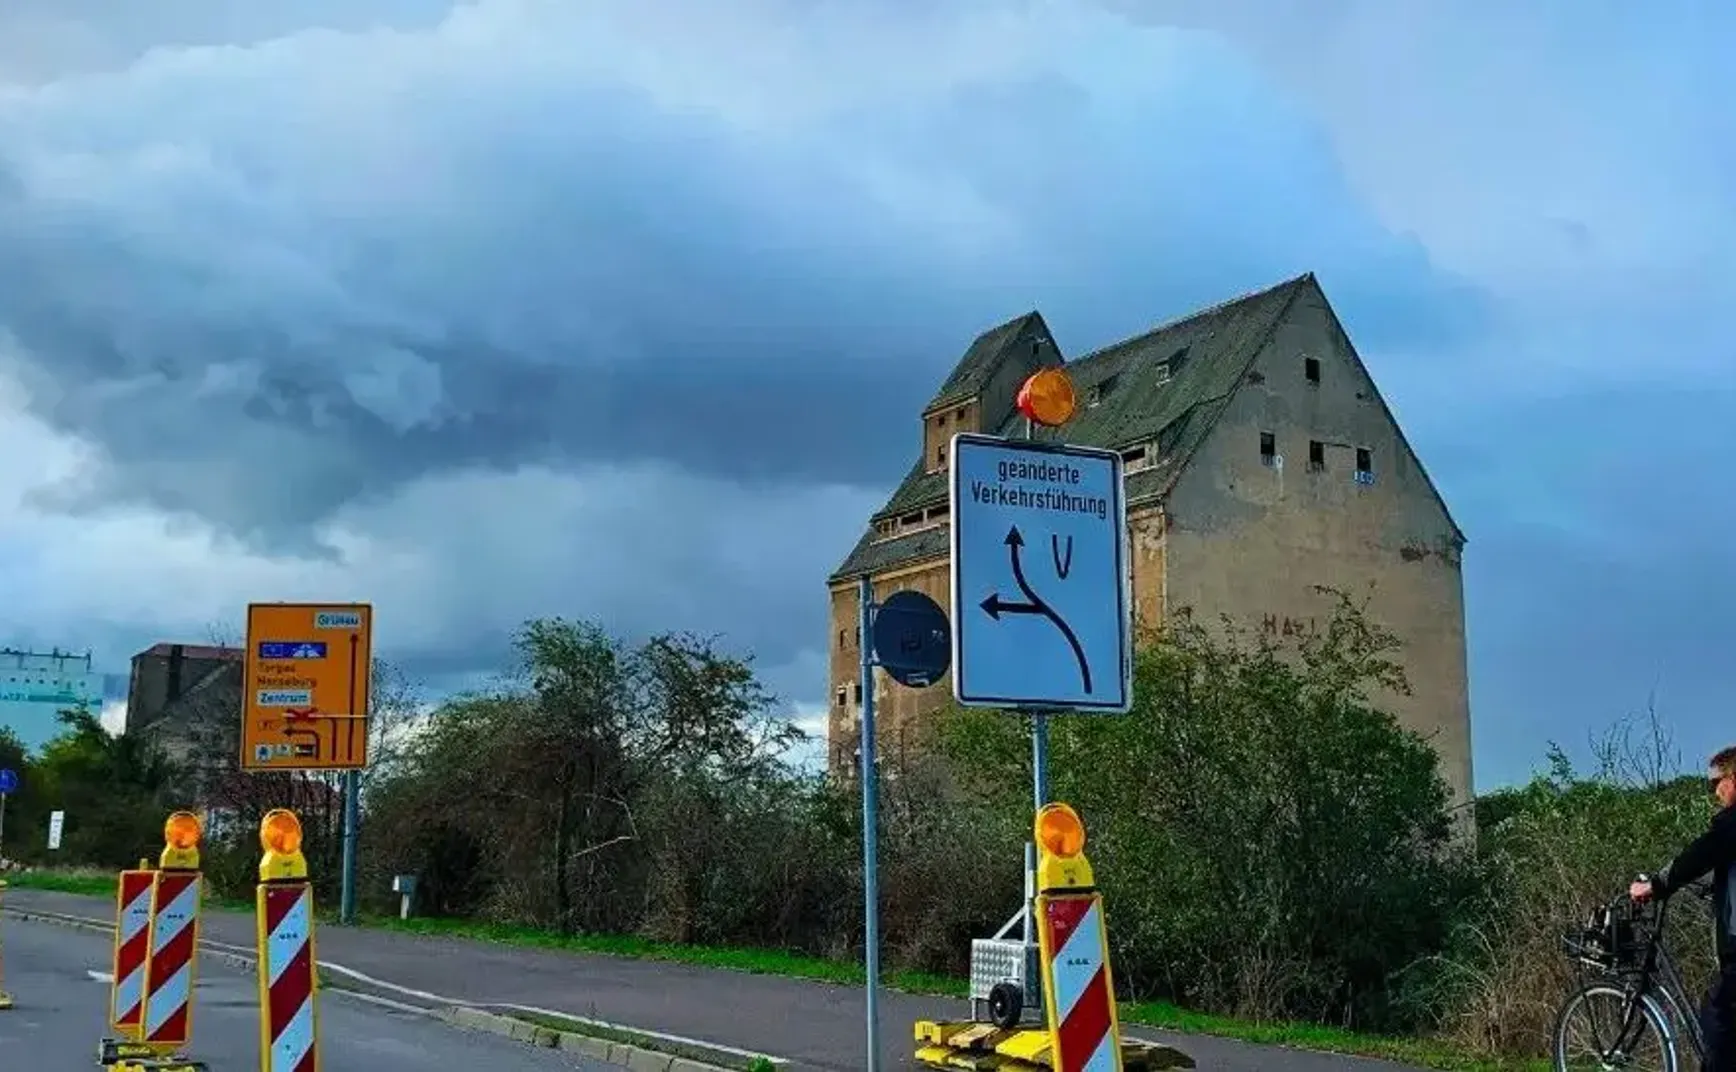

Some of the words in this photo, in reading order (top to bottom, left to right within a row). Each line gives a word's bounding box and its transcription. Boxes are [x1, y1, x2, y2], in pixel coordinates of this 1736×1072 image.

[998, 459, 1079, 484] geänderte
[971, 480, 1107, 520] Verkehrsführung
[260, 692, 308, 704] Zentrum
